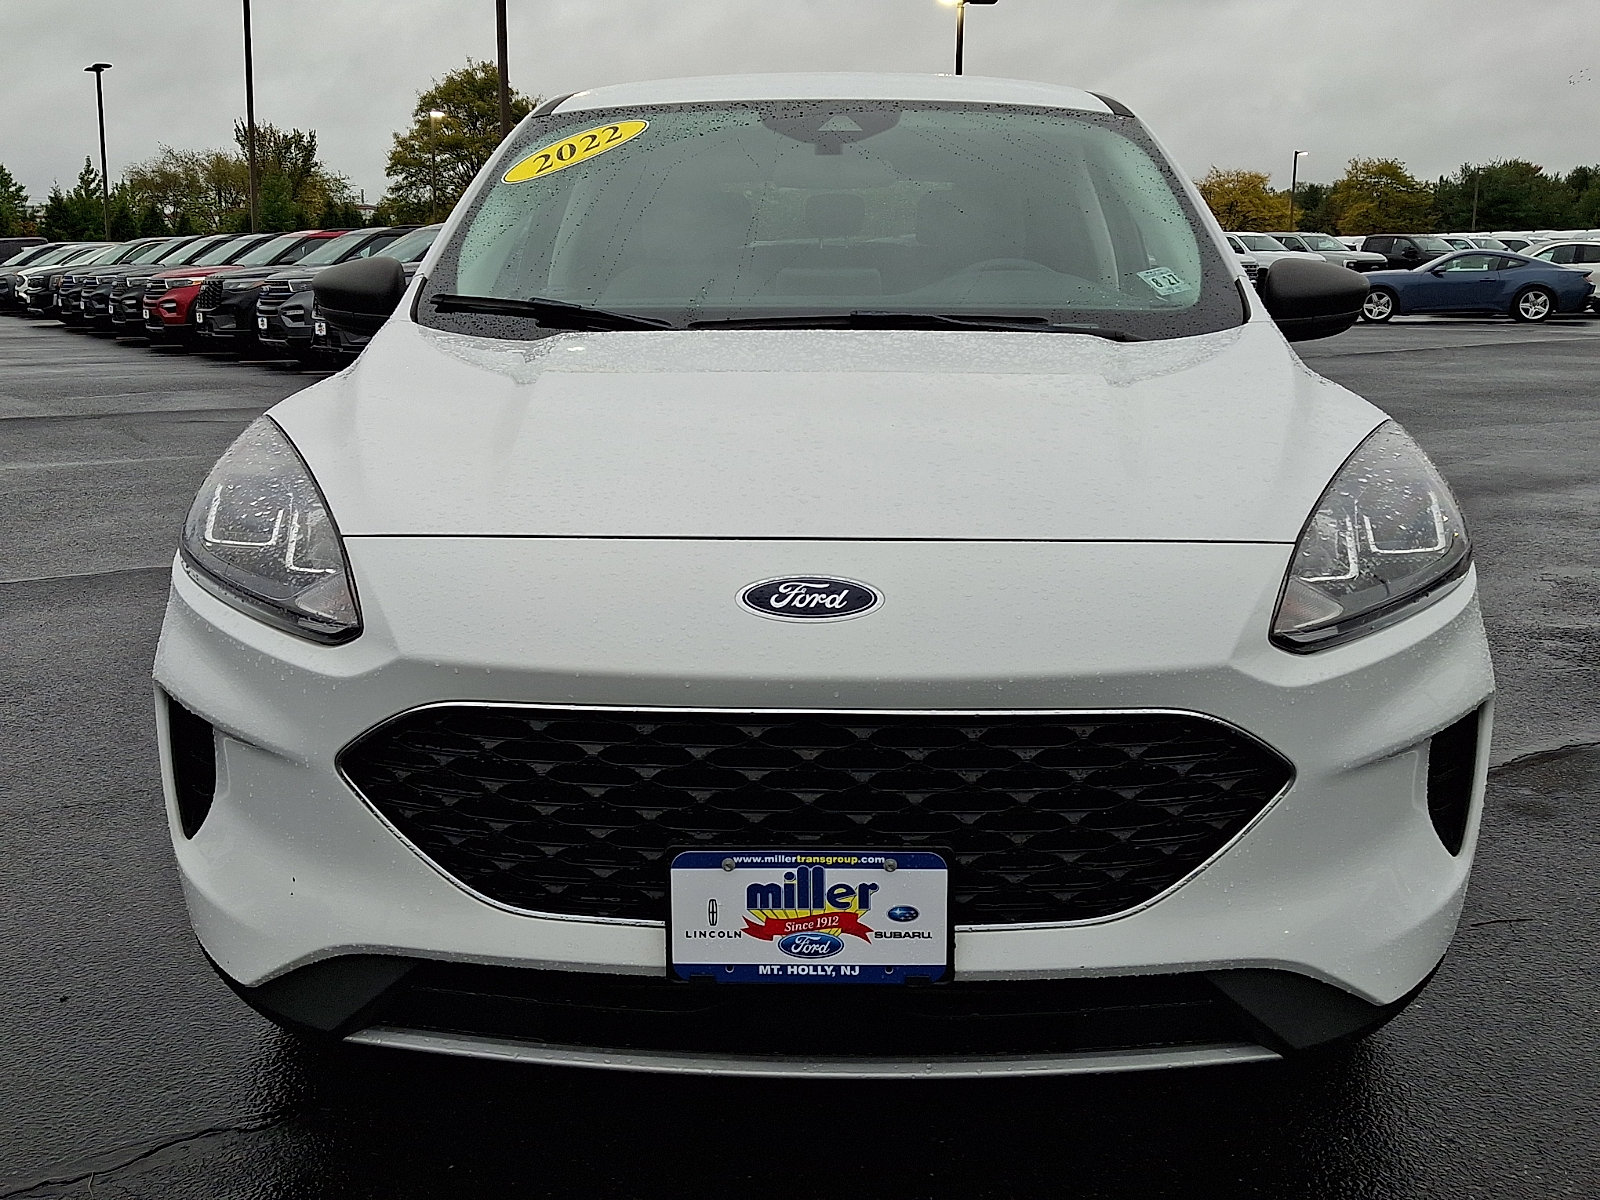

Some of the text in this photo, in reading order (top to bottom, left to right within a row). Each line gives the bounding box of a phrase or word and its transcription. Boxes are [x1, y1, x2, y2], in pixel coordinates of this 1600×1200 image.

[533, 126, 623, 174] 2022
[1152, 273, 1180, 288] 8 27
[770, 582, 849, 609] Ford
[734, 855, 885, 865] www.millertransgroup.com
[746, 865, 880, 910] miller
[784, 916, 839, 933] Since 1912
[685, 930, 742, 939] LINCOLN
[874, 931, 931, 939] SUBARU
[791, 936, 830, 954] Ford
[758, 966, 860, 977] MT. HOLLY, NJ
